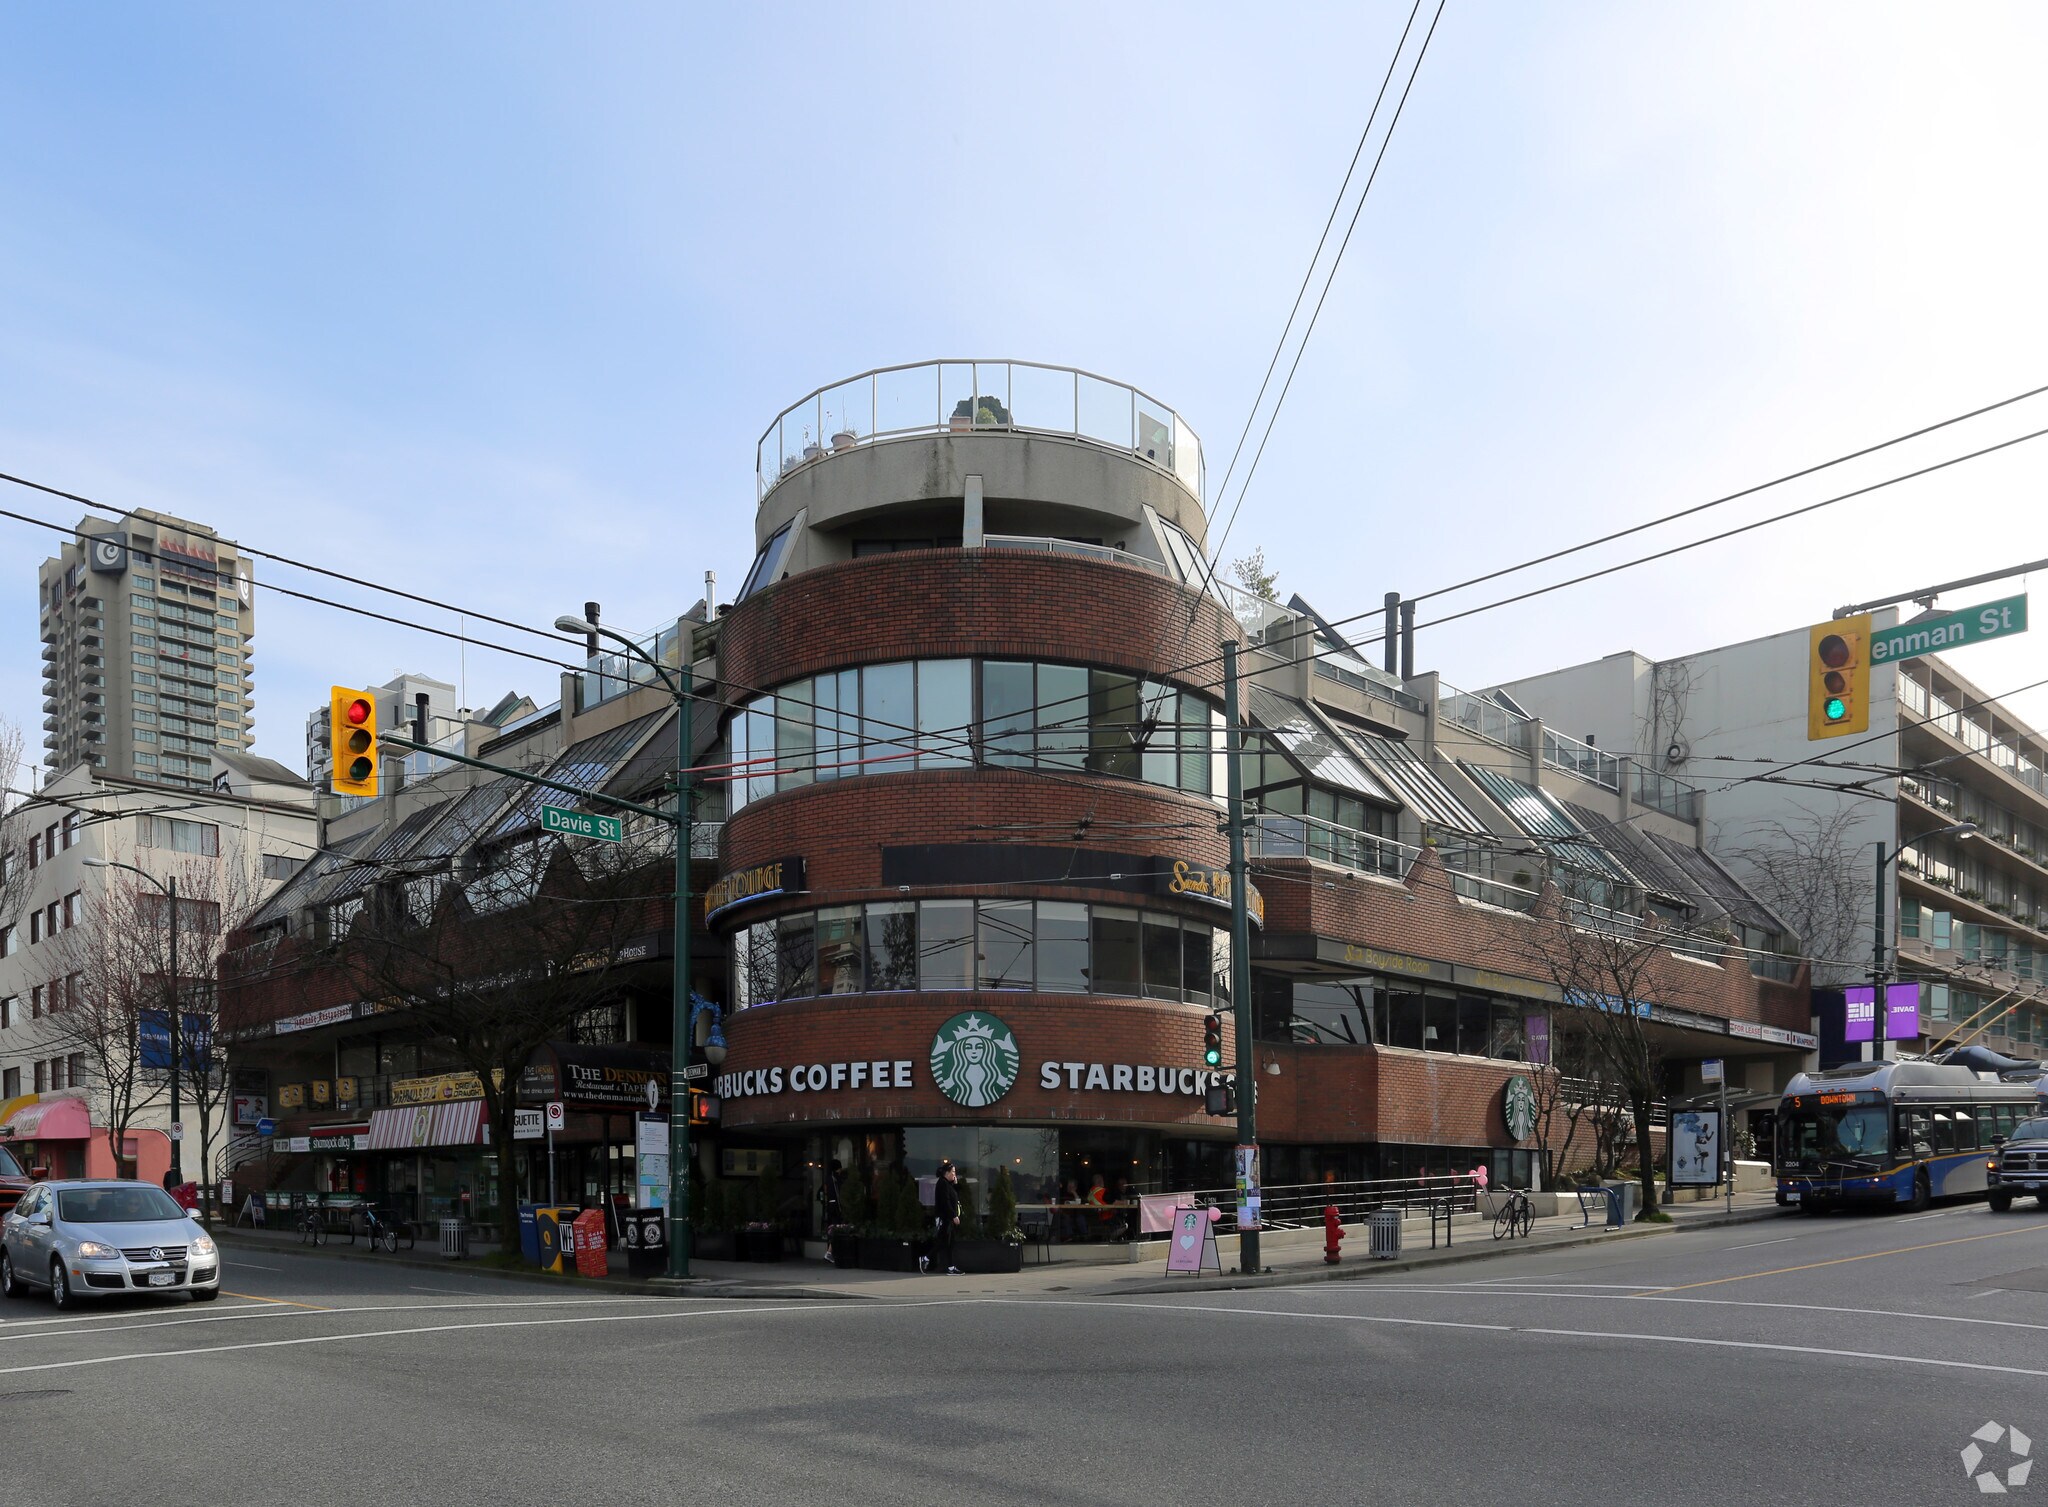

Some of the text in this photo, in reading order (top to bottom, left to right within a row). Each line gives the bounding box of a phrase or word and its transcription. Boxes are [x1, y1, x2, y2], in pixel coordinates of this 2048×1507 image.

[1872, 606, 2012, 660] enman St
[549, 810, 615, 838] Davie St
[1366, 948, 1404, 970] Bayside
[1406, 956, 1430, 974] Room
[1734, 1025, 1761, 1036] FOR LEASE
[567, 1063, 602, 1081] THE
[789, 1060, 913, 1092] COFFEE
[1040, 1061, 1220, 1097] STARBUCKS
[576, 1079, 615, 1091] Restaurant
[622, 1082, 668, 1095] TAPHSE
[1794, 1093, 1856, 1108] 5 DOWNTOWN
[514, 1114, 540, 1126] GUETTE
